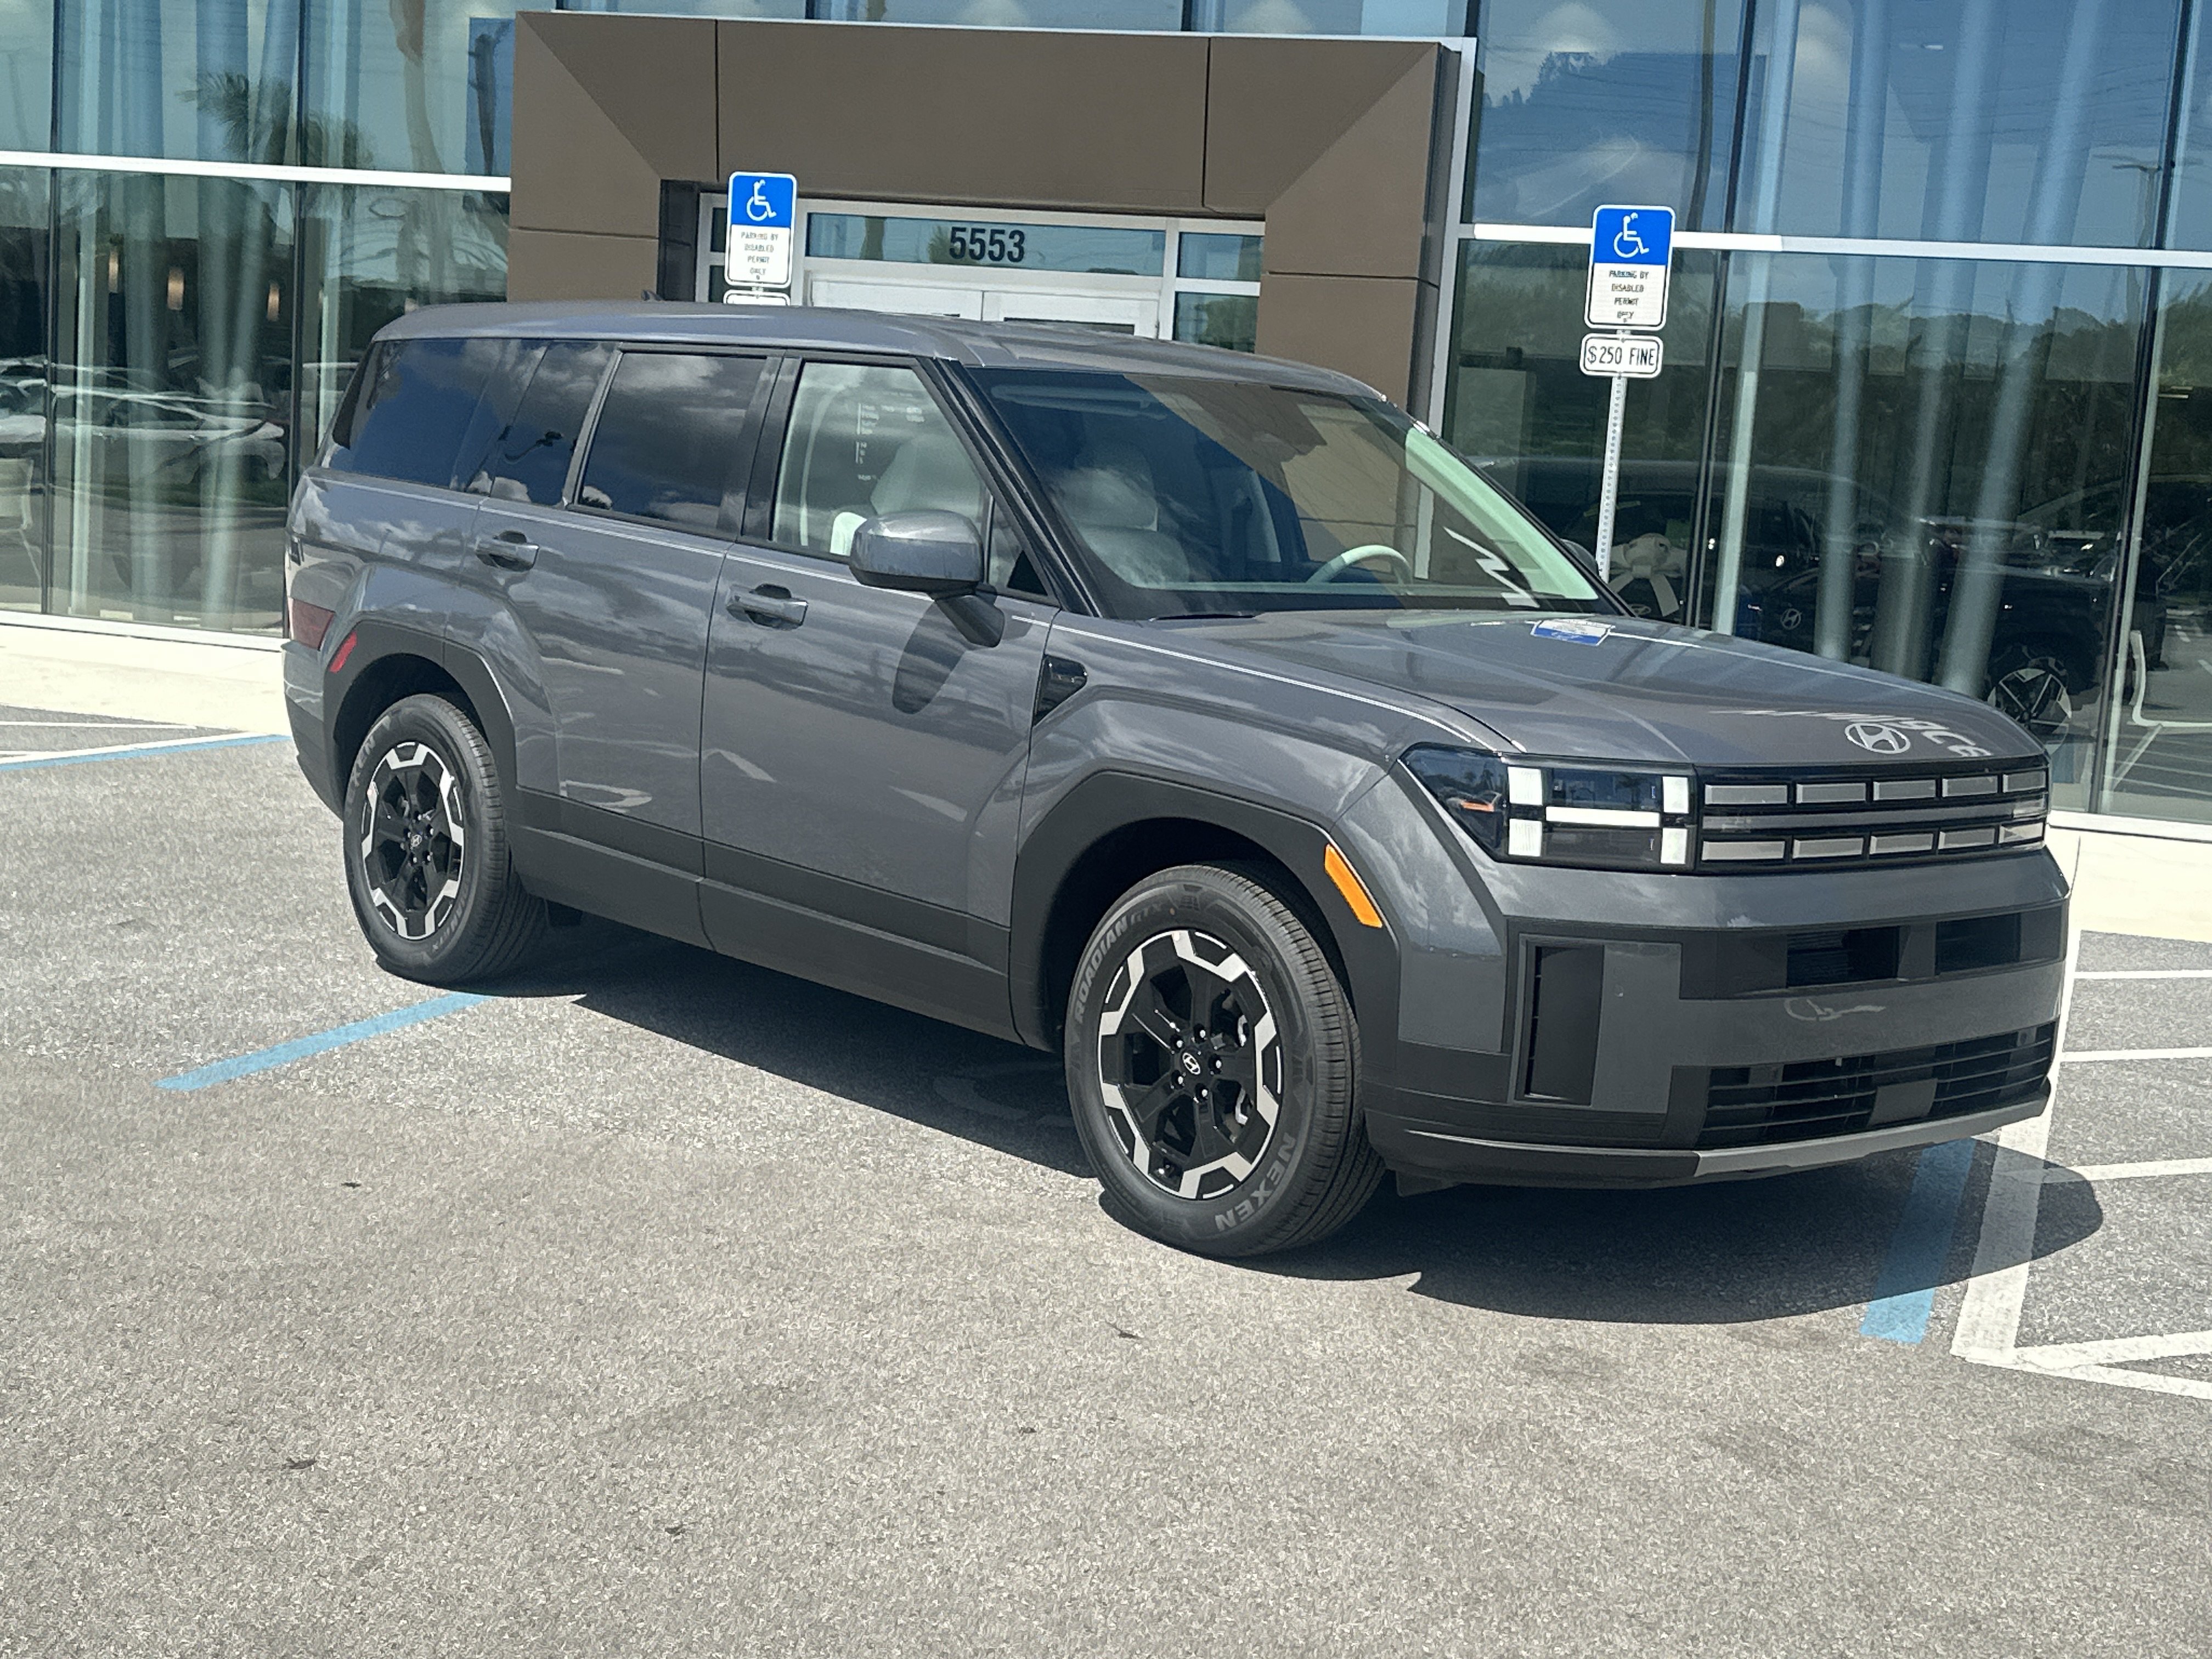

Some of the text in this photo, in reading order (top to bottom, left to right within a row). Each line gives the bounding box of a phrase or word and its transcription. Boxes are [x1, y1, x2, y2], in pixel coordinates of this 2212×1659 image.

[949, 227, 1025, 262] 5553
[748, 255, 770, 263] PERT
[1640, 270, 1649, 279] BY
[1611, 283, 1644, 292] DISABLED
[1617, 311, 1634, 319] OY
[1587, 345, 1656, 366] $250 FINE
[1074, 915, 1128, 1024] ROADIAN
[1214, 1132, 1296, 1232] NEXEN
